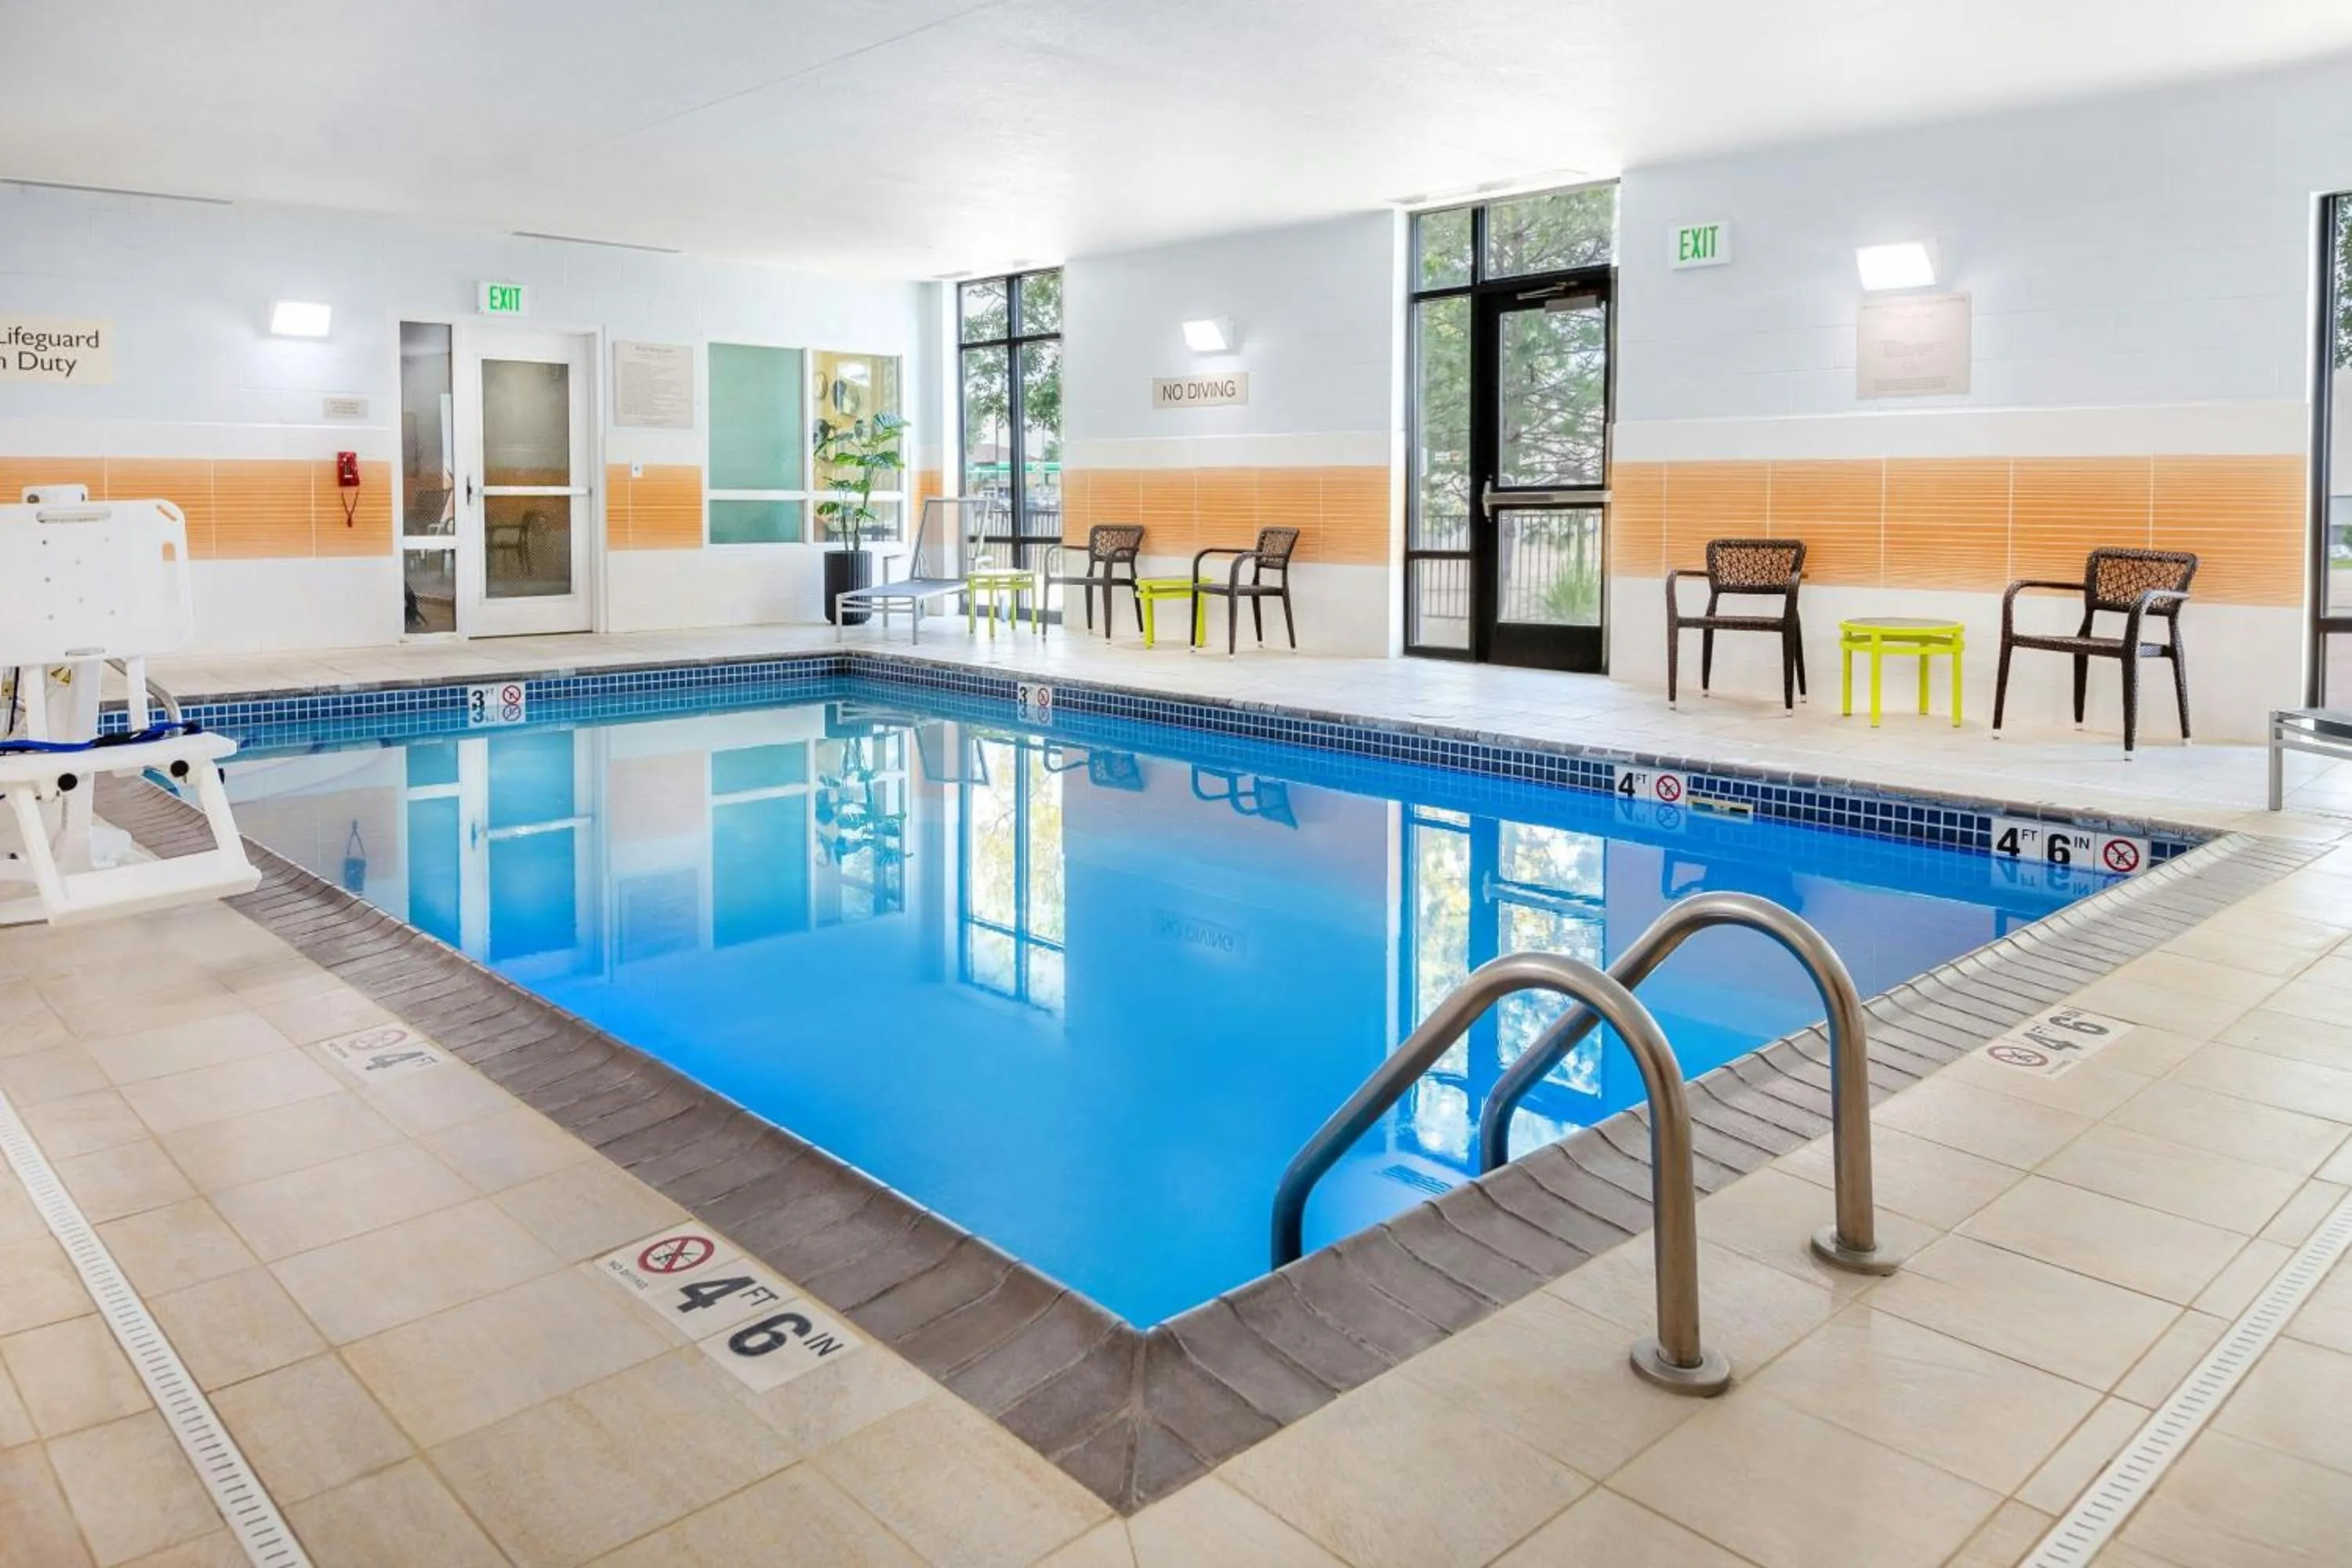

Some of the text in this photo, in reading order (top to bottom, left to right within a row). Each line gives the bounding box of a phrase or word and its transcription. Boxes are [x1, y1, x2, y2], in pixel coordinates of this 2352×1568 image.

[1680, 226, 1719, 260] EXIT
[490, 286, 521, 311] EXIT
[18, 350, 78, 377] Duty
[1162, 380, 1236, 401] NO DIVING
[471, 690, 485, 710] 3
[1019, 687, 1027, 703] 3
[1618, 772, 1648, 797] 4 FT
[1997, 827, 2090, 864] 4 FT 6 IN
[2049, 1015, 2110, 1036] 6
[2022, 1033, 2083, 1051] 4
[365, 1051, 425, 1071] 4
[677, 1276, 844, 1358] 4 FT 6 IN
